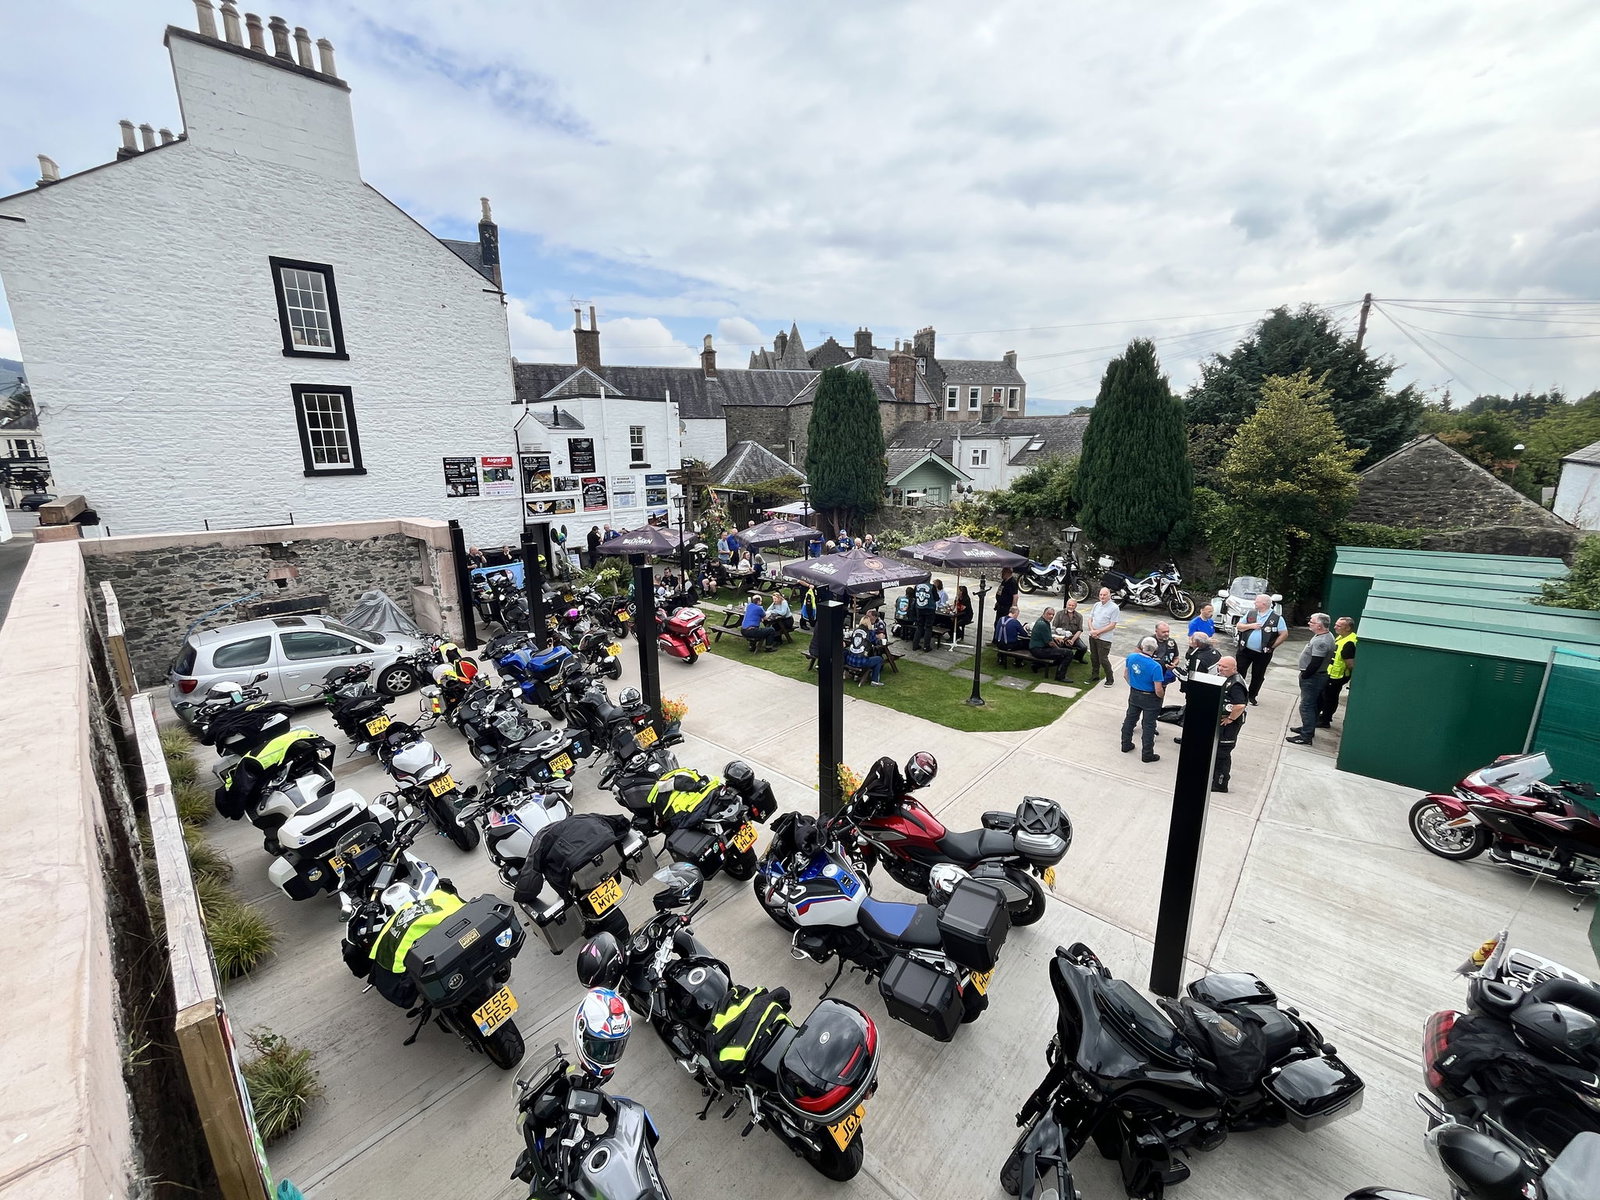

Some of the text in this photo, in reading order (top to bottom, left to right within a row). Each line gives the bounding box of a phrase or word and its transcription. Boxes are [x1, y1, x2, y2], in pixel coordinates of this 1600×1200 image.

[368, 717, 387, 729] PF74
[733, 823, 752, 843] PX25
[740, 832, 755, 849] HLM
[589, 879, 616, 903] SL22
[597, 890, 618, 909] MVK
[475, 988, 509, 1021] YE55
[486, 1002, 511, 1028] DES
